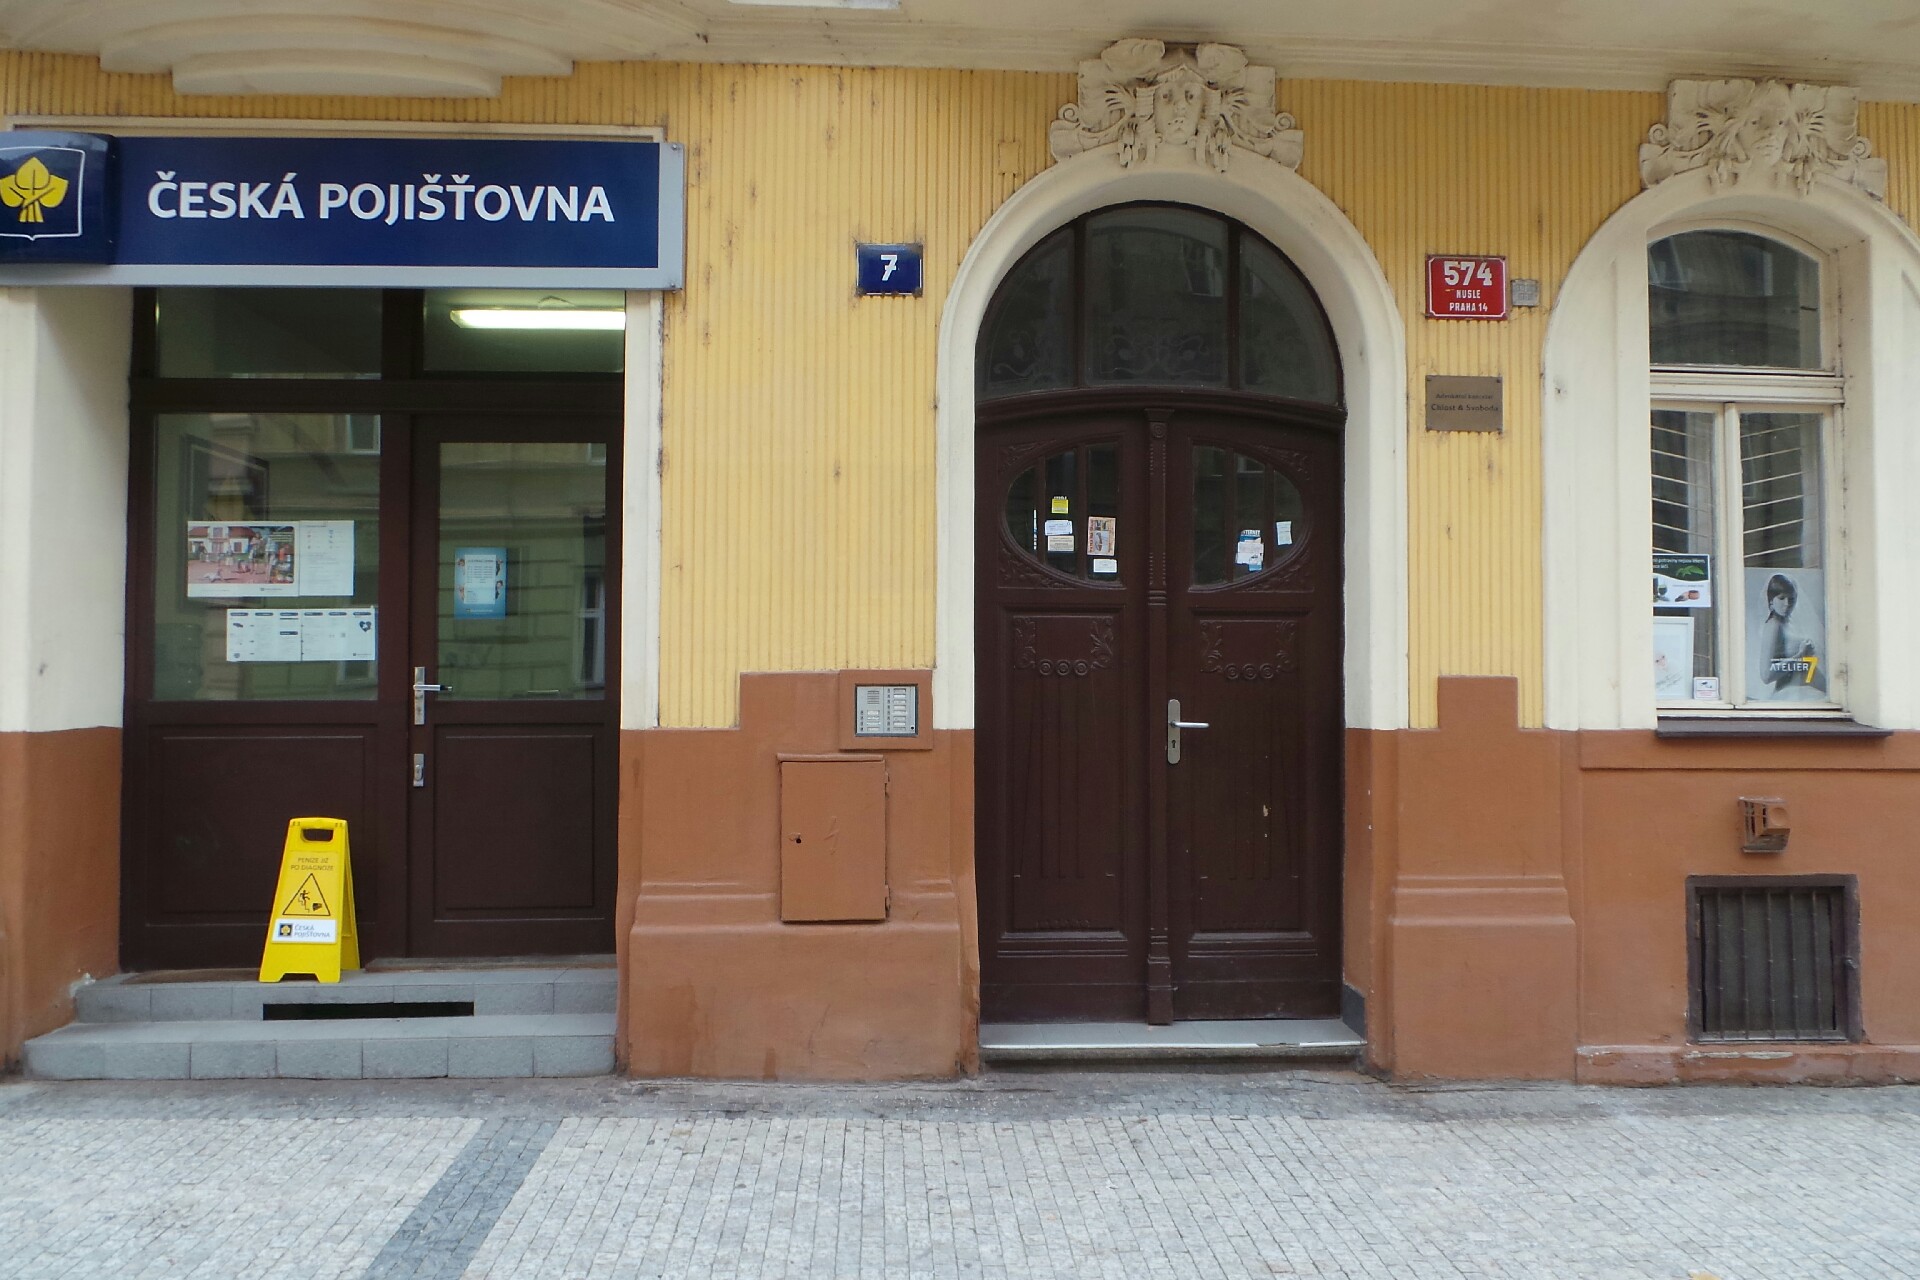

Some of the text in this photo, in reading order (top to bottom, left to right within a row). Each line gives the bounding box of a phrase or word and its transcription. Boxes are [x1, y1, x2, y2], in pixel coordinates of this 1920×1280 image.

[148, 170, 615, 226] ČESKÁ POJIŠŤOVNA
[880, 254, 898, 281] 7
[1444, 260, 1493, 286] 574
[1449, 302, 1488, 312] PRAHA 14
[1456, 289, 1481, 299] NUSLE
[1770, 656, 1818, 683] ATELIER 7
